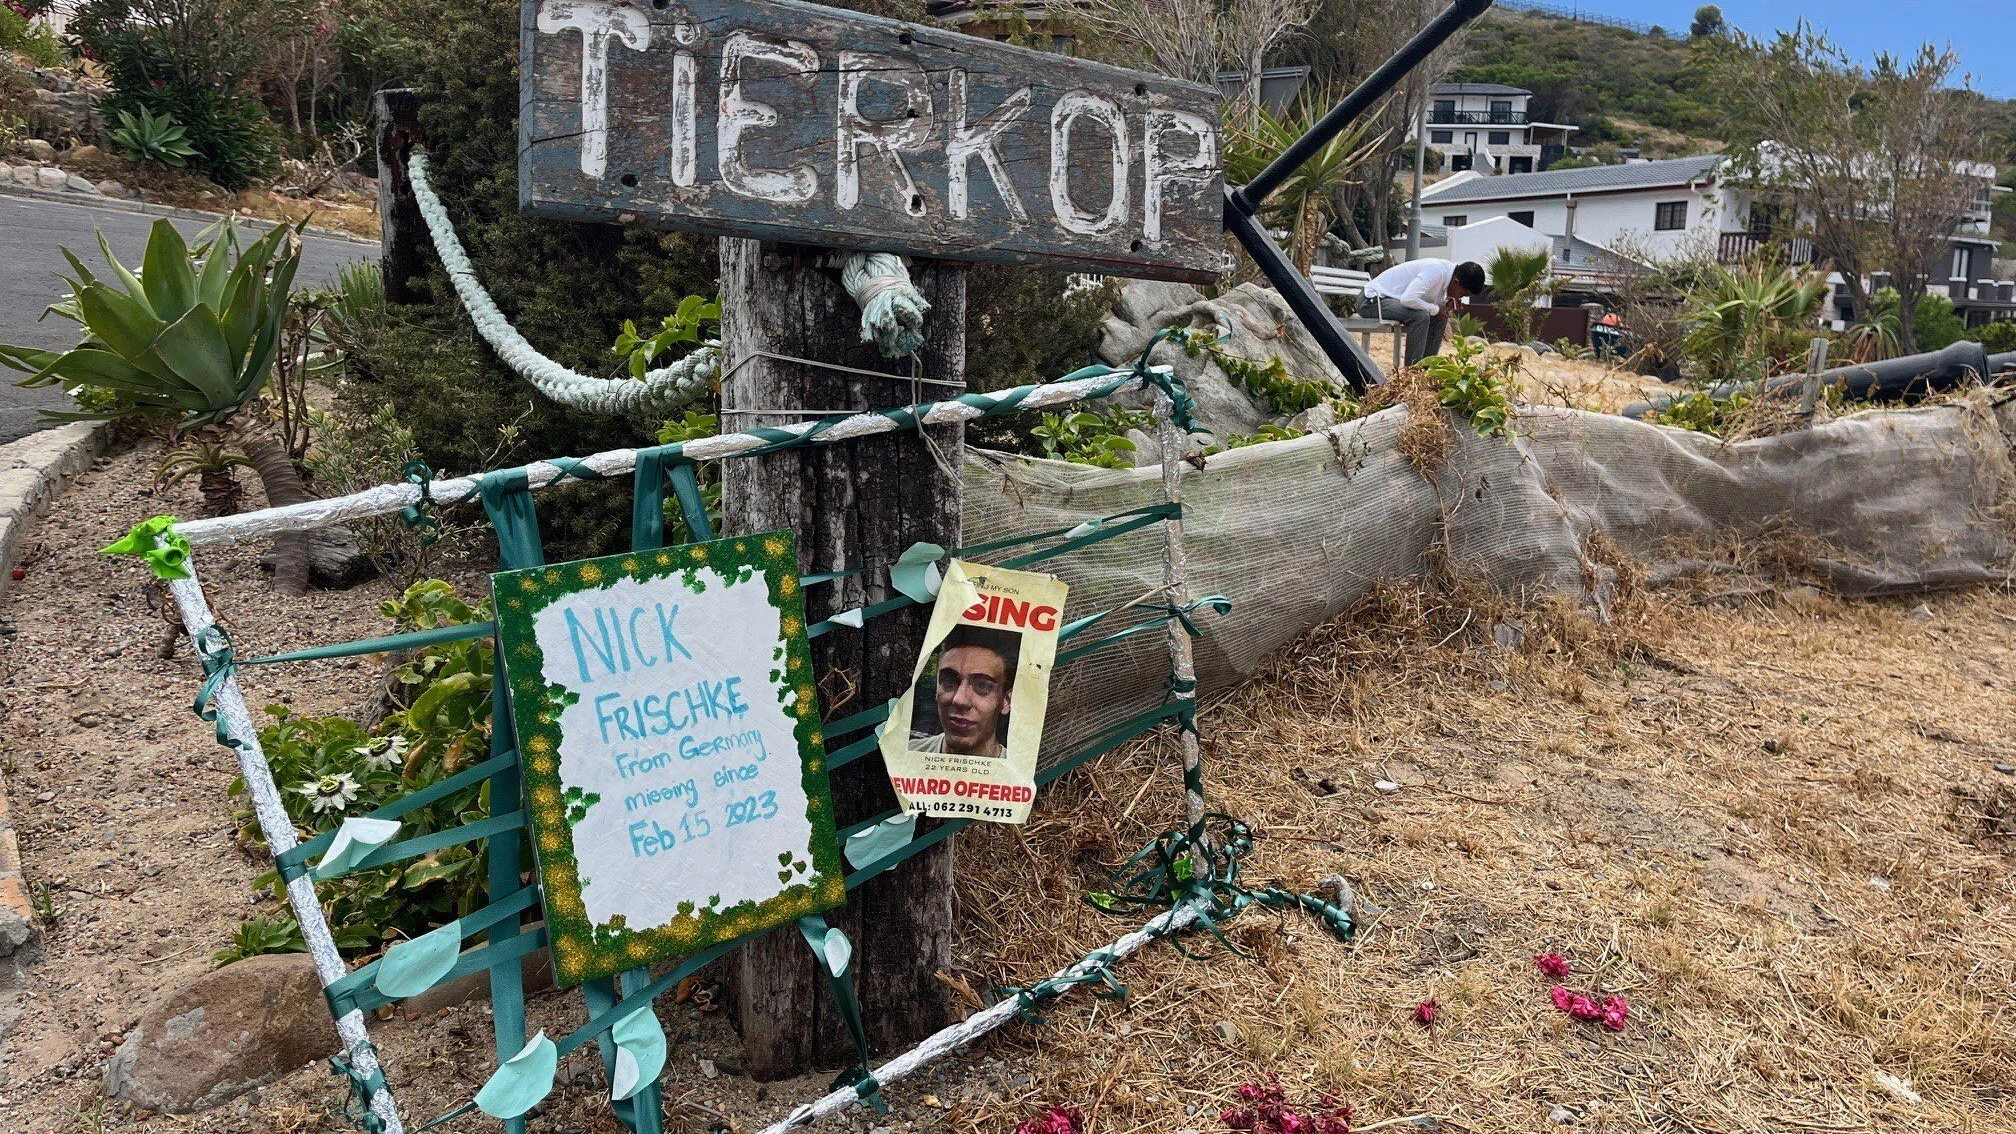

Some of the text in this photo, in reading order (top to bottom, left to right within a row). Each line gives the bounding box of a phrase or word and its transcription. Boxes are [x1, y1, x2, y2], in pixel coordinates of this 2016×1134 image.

[990, 584, 1003, 592] MY
[1003, 587, 1020, 595] SON
[962, 593, 1058, 631] SING
[563, 602, 692, 683] NICK
[594, 676, 749, 745] FRISCHKE
[615, 752, 672, 779] From
[938, 765, 968, 773] YEARS
[971, 767, 990, 775] OLD
[948, 757, 992, 767] FRISCHKE
[625, 763, 759, 809] missing since
[892, 777, 1032, 803] EWARD OFFERED
[629, 789, 779, 857] Feb 15 2023
[908, 801, 1013, 818] ALL: 062 291 4713
